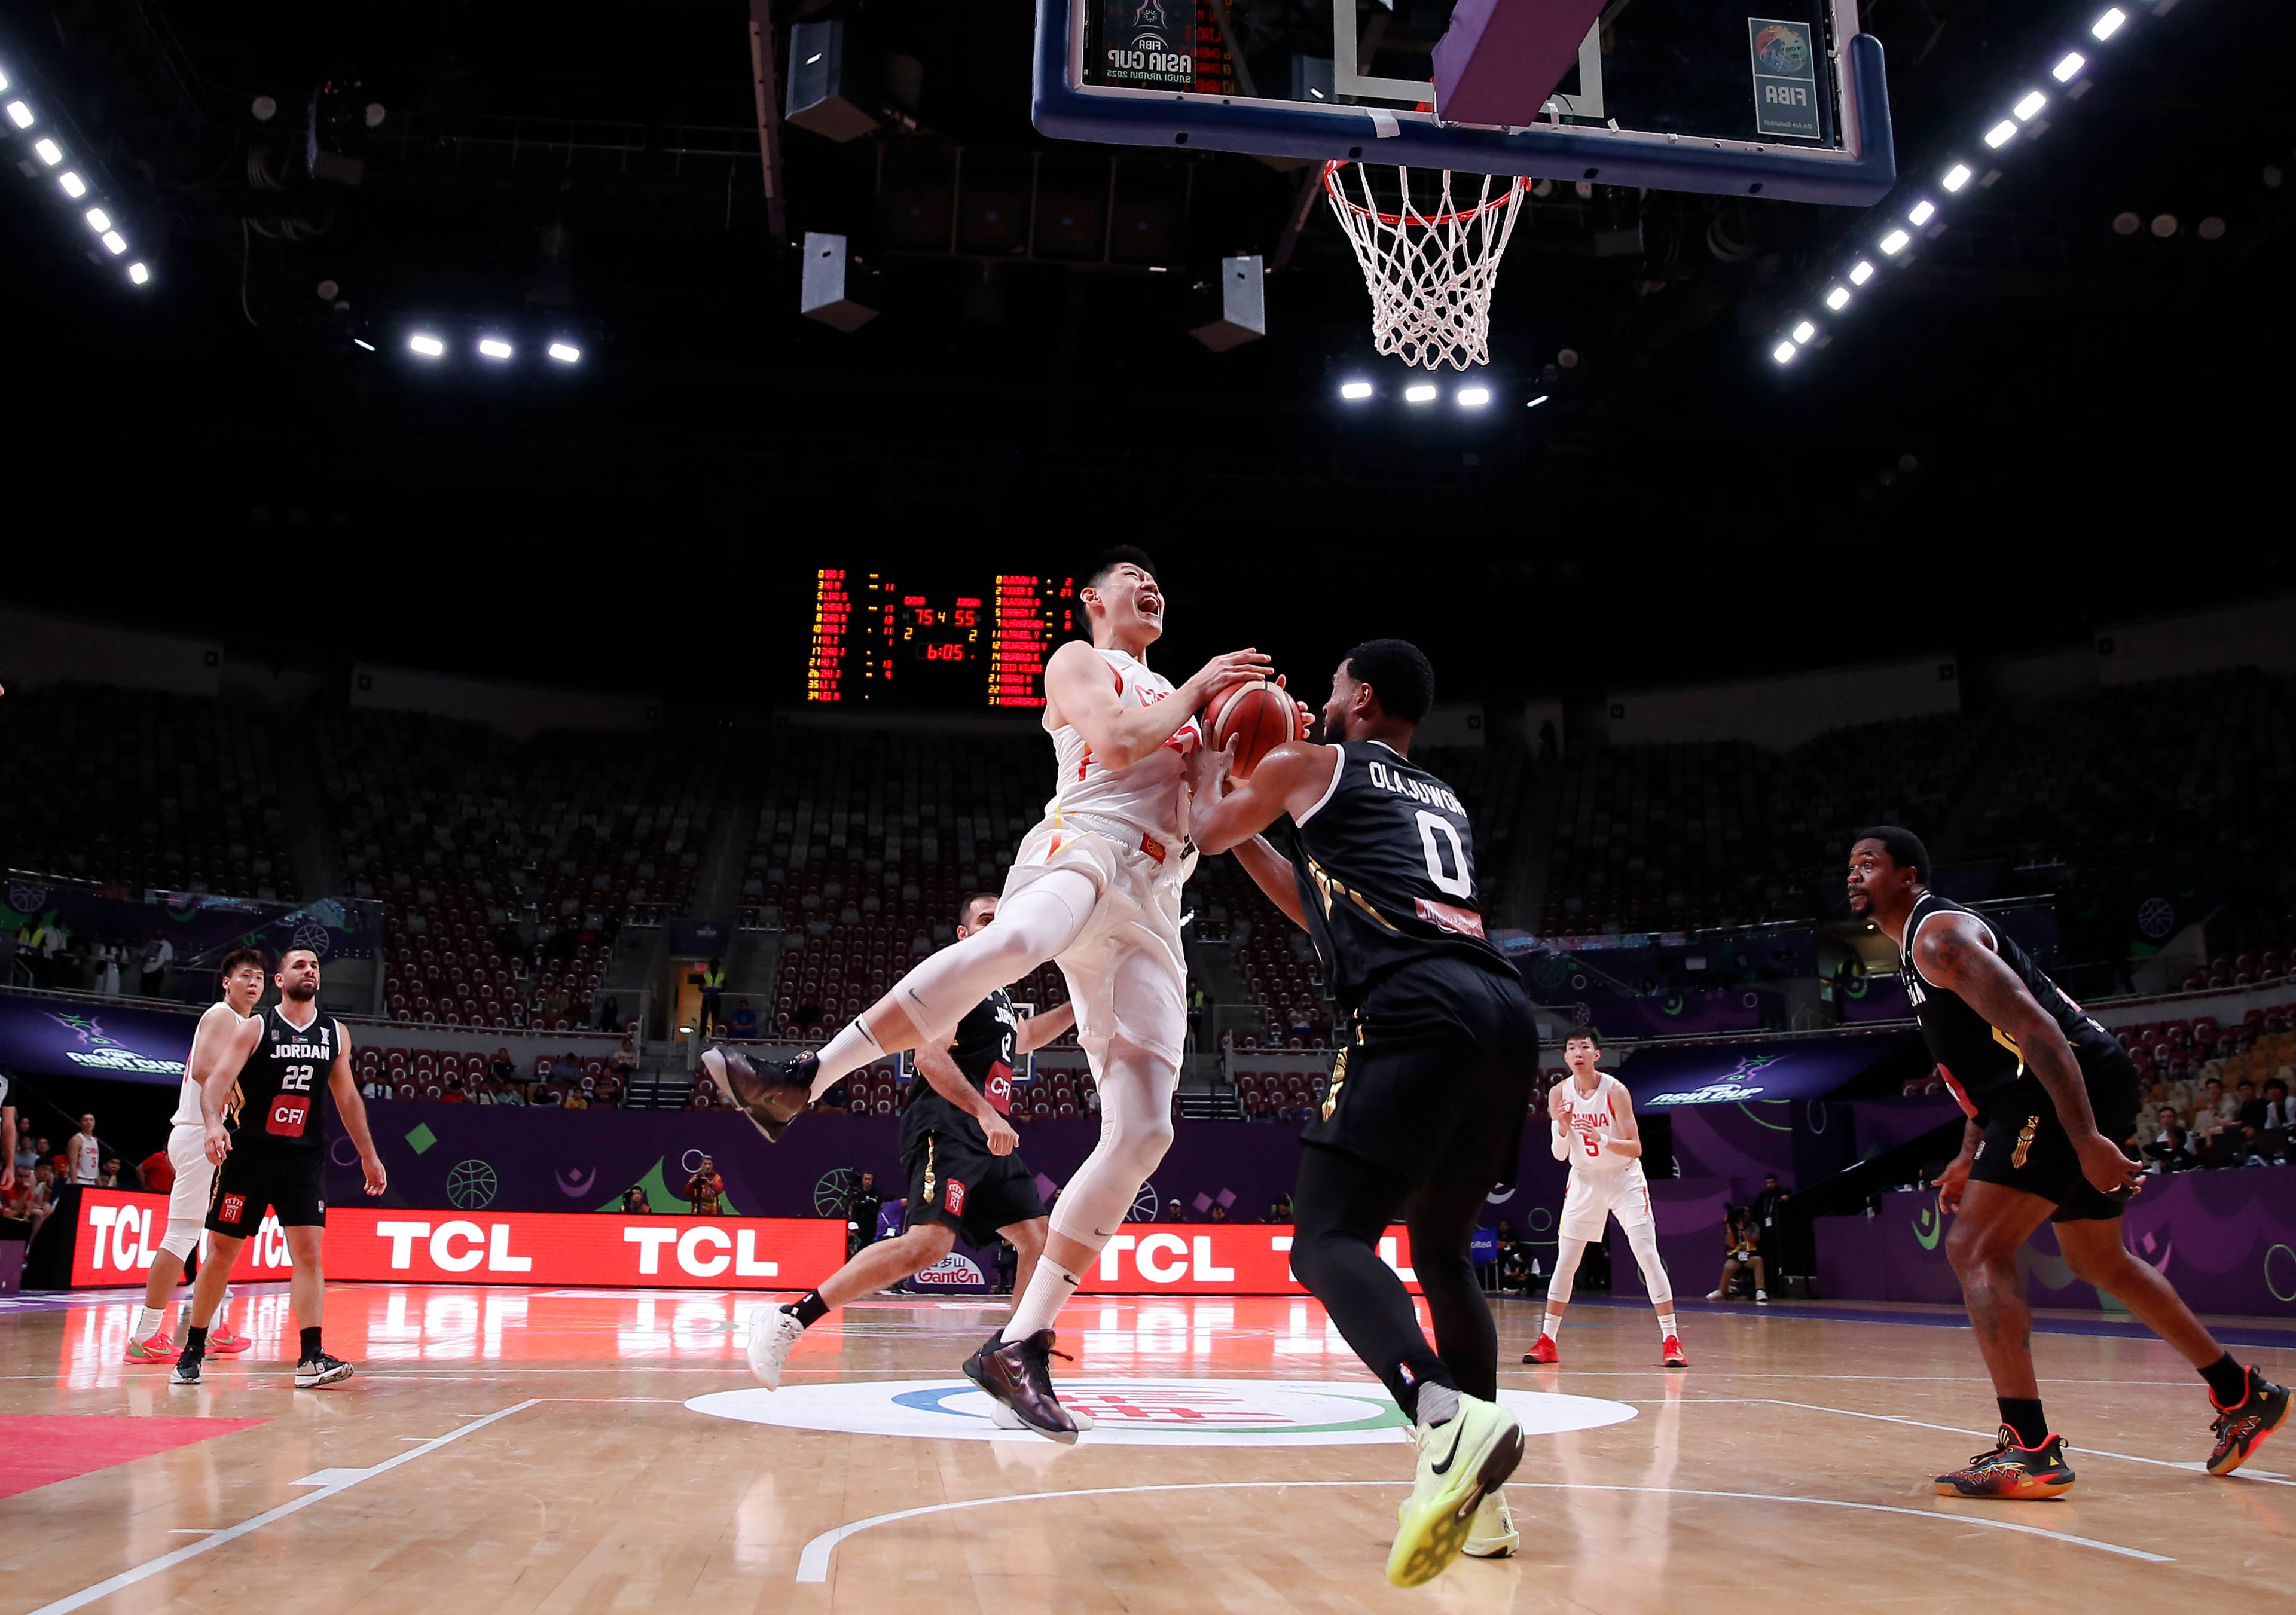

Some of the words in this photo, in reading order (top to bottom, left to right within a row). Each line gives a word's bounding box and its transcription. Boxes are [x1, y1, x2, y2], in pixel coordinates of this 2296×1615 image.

[818, 581, 823, 590] 3
[1060, 588, 1073, 598] 27
[817, 591, 823, 600] 5
[842, 592, 848, 602] S
[996, 597, 1002, 606] 3
[845, 603, 851, 612] S
[995, 608, 1001, 616] 5
[915, 609, 933, 625] 75
[938, 612, 945, 622] 4
[954, 610, 975, 626] 55
[904, 627, 913, 639] 2
[969, 629, 978, 642] 2
[927, 644, 963, 660] 6:05
[809, 658, 820, 667] 21
[808, 669, 819, 677] 26
[988, 674, 1000, 683] 21
[808, 680, 819, 689] 35
[819, 680, 828, 689] LI
[988, 685, 1000, 694] 22
[808, 691, 819, 700] 39
[819, 692, 831, 701] LEI
[1369, 761, 1467, 817] OLAJUWON
[1415, 809, 1471, 900] 0
[270, 1043, 330, 1061] JORDAN
[66, 1051, 133, 1067] ASIA
[131, 1058, 185, 1070] CUP
[282, 1064, 314, 1091] 22
[1650, 1091, 1712, 1102] ASIA
[1710, 1087, 1764, 1099] CUP
[274, 1107, 304, 1125] CFI
[1583, 1134, 1599, 1157] 5
[949, 1196, 960, 1212] RJ
[225, 1208, 236, 1220] RJ
[89, 1205, 157, 1271] TCL
[376, 1220, 532, 1272] TCL
[624, 1226, 778, 1277] TCL
[929, 1256, 966, 1268] 岁山
[1100, 1232, 1235, 1283] TCL
